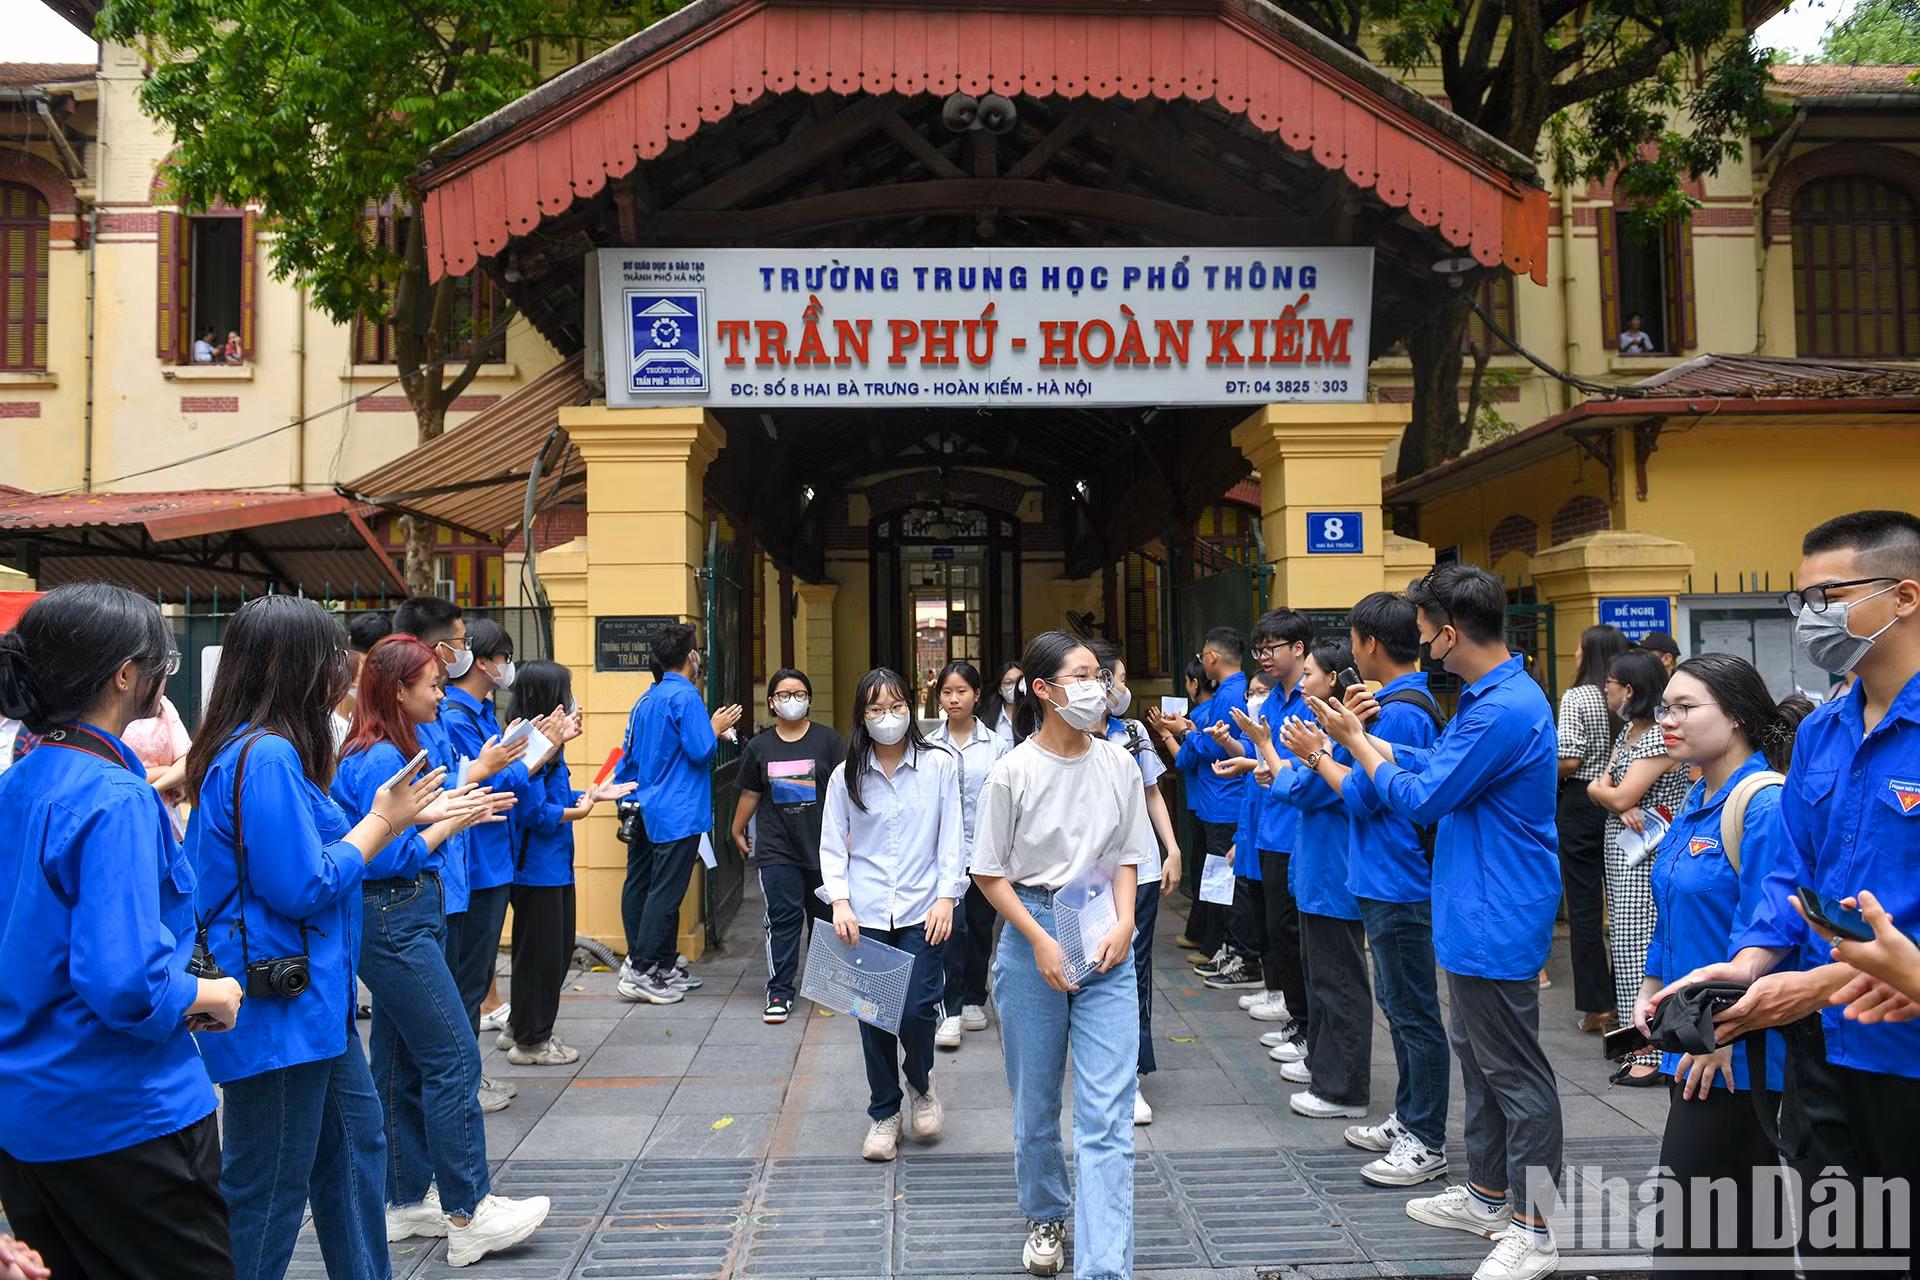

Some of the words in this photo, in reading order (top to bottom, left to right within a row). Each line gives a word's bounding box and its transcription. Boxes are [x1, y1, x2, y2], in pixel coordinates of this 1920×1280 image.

[692, 262, 705, 272] TẠO
[623, 272, 652, 281] THÀNH
[654, 272, 672, 281] PHỐ
[674, 272, 687, 281] HÀ
[689, 272, 705, 283] NỘI
[759, 259, 899, 291] TRƯỜNG
[913, 266, 1027, 291] TRUNG
[1042, 266, 1108, 296] HỌC
[1203, 261, 1317, 290] THÔNG
[717, 294, 873, 366] TRẦN
[887, 302, 998, 365] PHÚ
[1011, 338, 1027, 349] -
[1039, 303, 1194, 365] HOÀN
[1206, 293, 1353, 364] KIẾM
[731, 382, 758, 396] ĐC:
[763, 378, 787, 396] SỐ
[791, 382, 799, 396] 8
[804, 382, 831, 396] HAI
[838, 379, 860, 396] BÀ
[864, 381, 919, 396] TRƯNG
[934, 379, 980, 395] HOÀN
[985, 377, 1022, 395] KIẾM
[1037, 379, 1060, 395] HÀ
[1065, 379, 1092, 397] NỘI
[1225, 381, 1250, 393] ĐT:
[1254, 381, 1271, 393] 04
[1276, 381, 1310, 393] 3825
[1323, 517, 1344, 541] 8
[1630, 606, 1655, 617] NGHỊ
[617, 652, 639, 665] TRẦN
[835, 970, 872, 994] CLEAR
